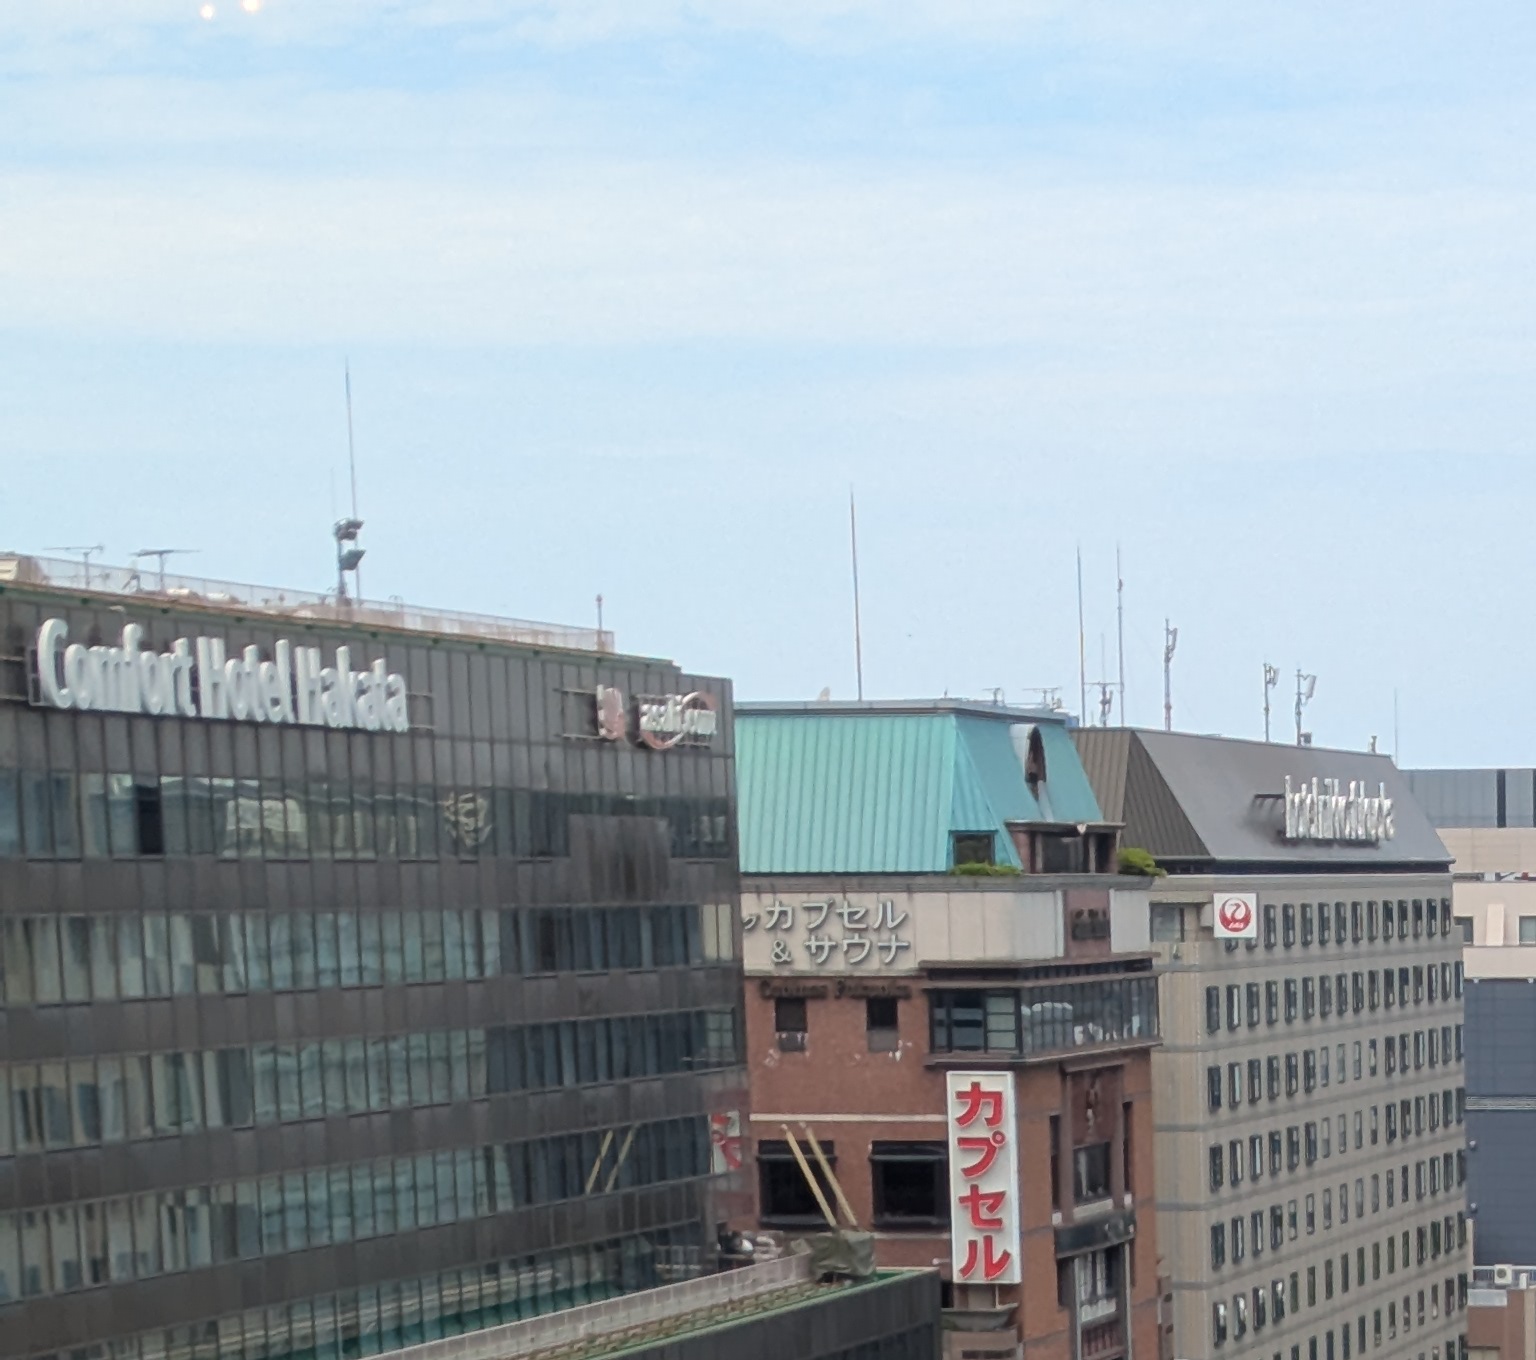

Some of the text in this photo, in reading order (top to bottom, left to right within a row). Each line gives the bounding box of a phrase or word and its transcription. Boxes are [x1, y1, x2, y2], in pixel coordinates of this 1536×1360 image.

[37, 617, 410, 733] Comfort Hotel Hakata
[771, 933, 910, 964] & サウナ
[955, 1080, 1012, 1281] カプセル
